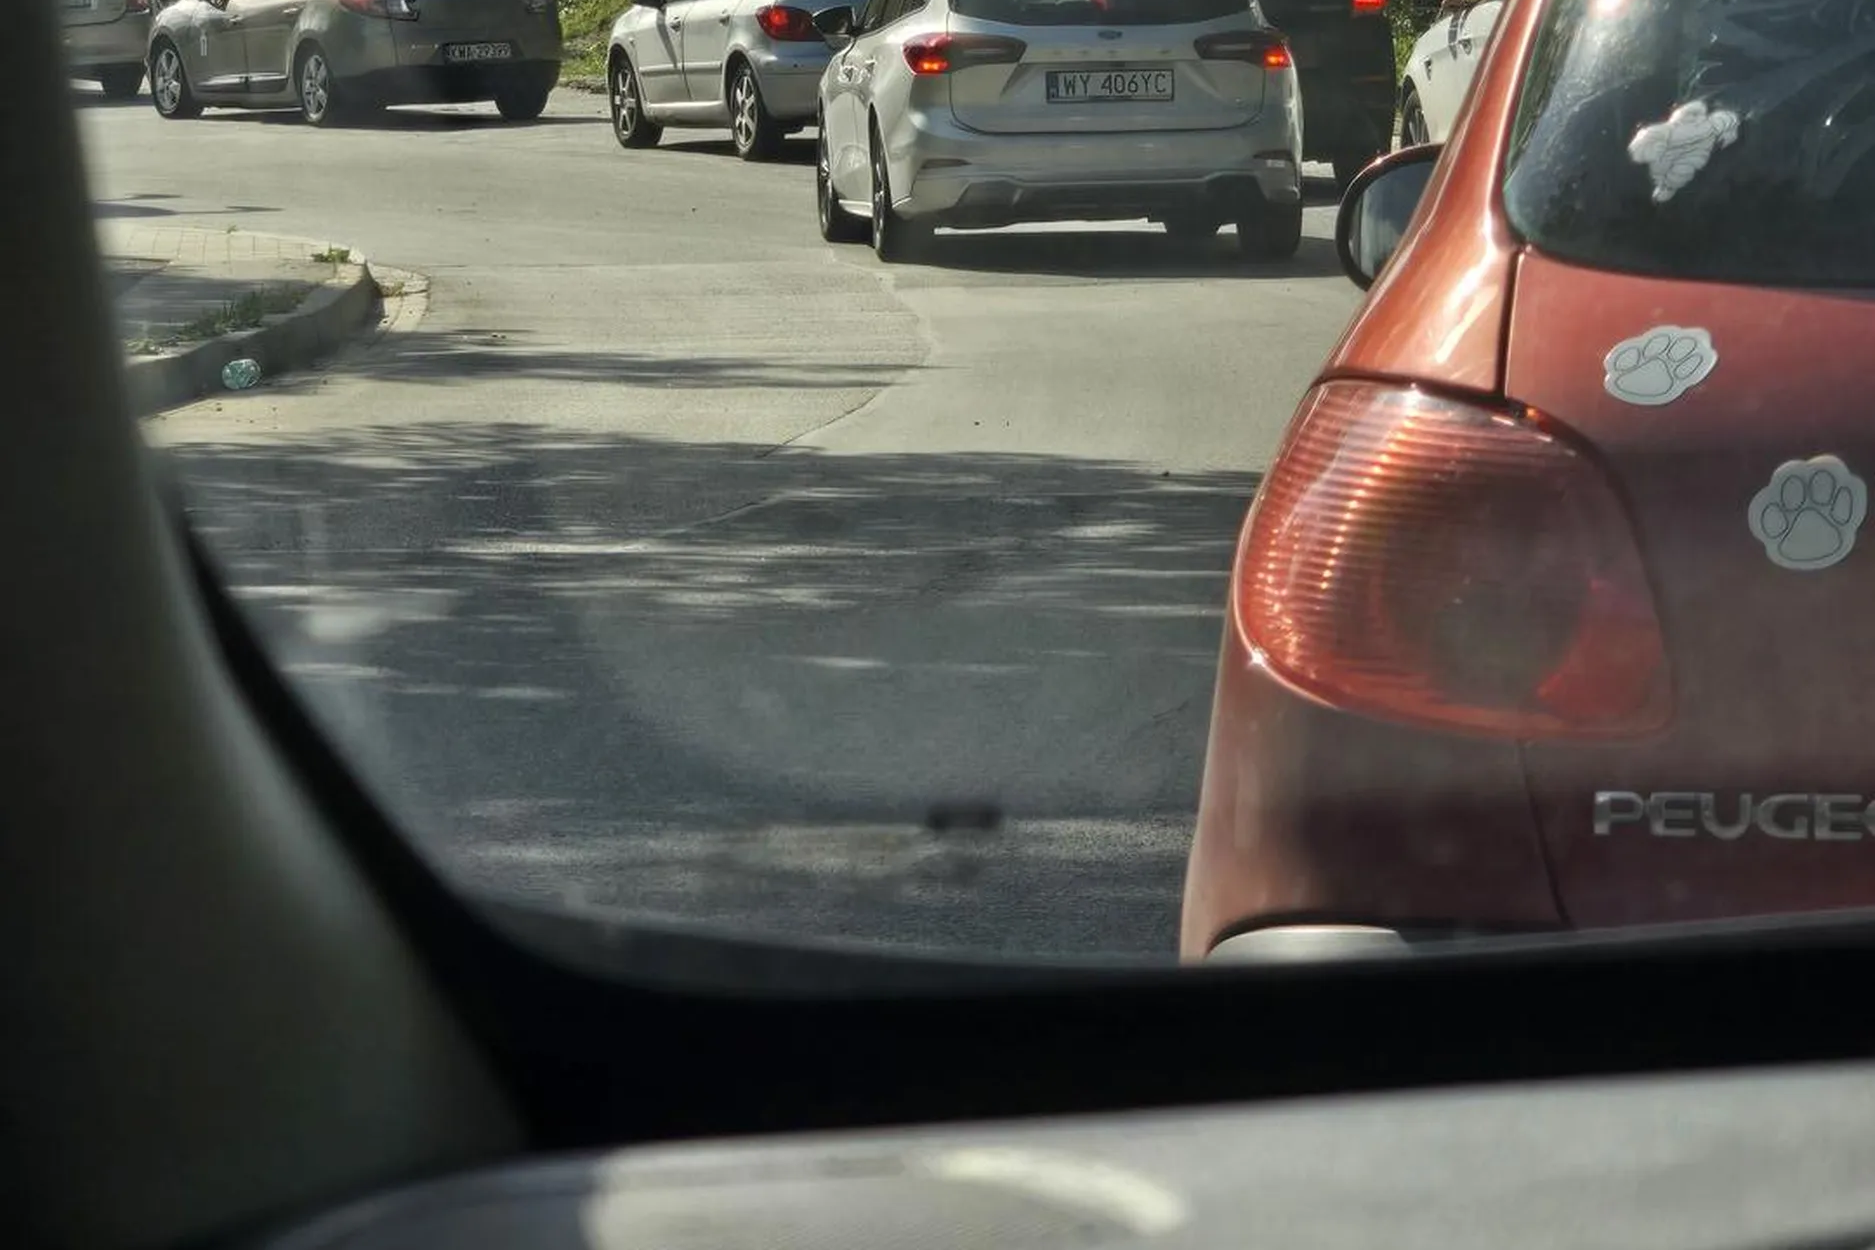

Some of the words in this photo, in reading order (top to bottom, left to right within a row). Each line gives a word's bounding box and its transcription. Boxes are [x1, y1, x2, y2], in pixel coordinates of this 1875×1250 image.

[1063, 74, 1090, 97] WY
[1100, 72, 1167, 95] 406YC
[1594, 791, 1875, 840] PEUGE
